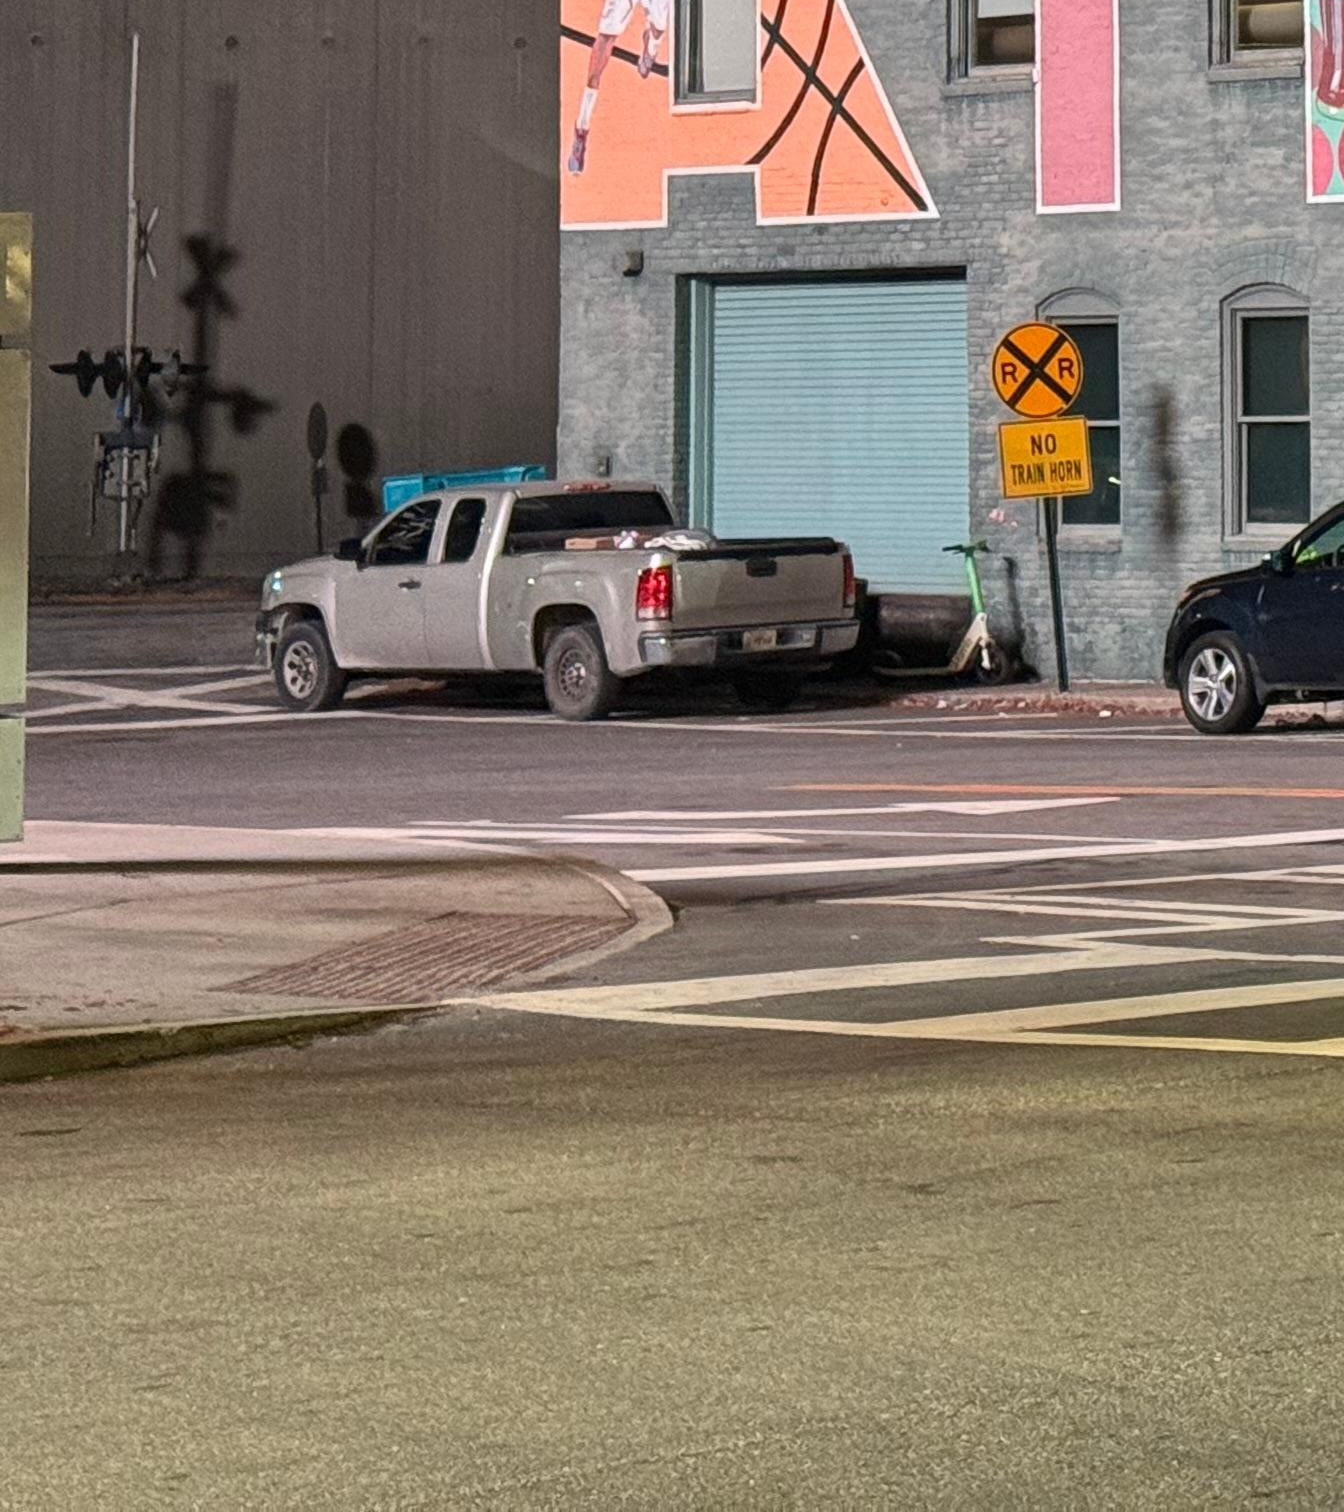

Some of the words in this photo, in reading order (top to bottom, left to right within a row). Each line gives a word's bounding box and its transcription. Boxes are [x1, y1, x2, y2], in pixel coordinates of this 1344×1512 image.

[1001, 362, 1019, 385] R
[1057, 357, 1076, 380] R
[1030, 433, 1057, 457] NO
[1010, 461, 1046, 487] TRAIN
[1050, 458, 1083, 483] HORN
